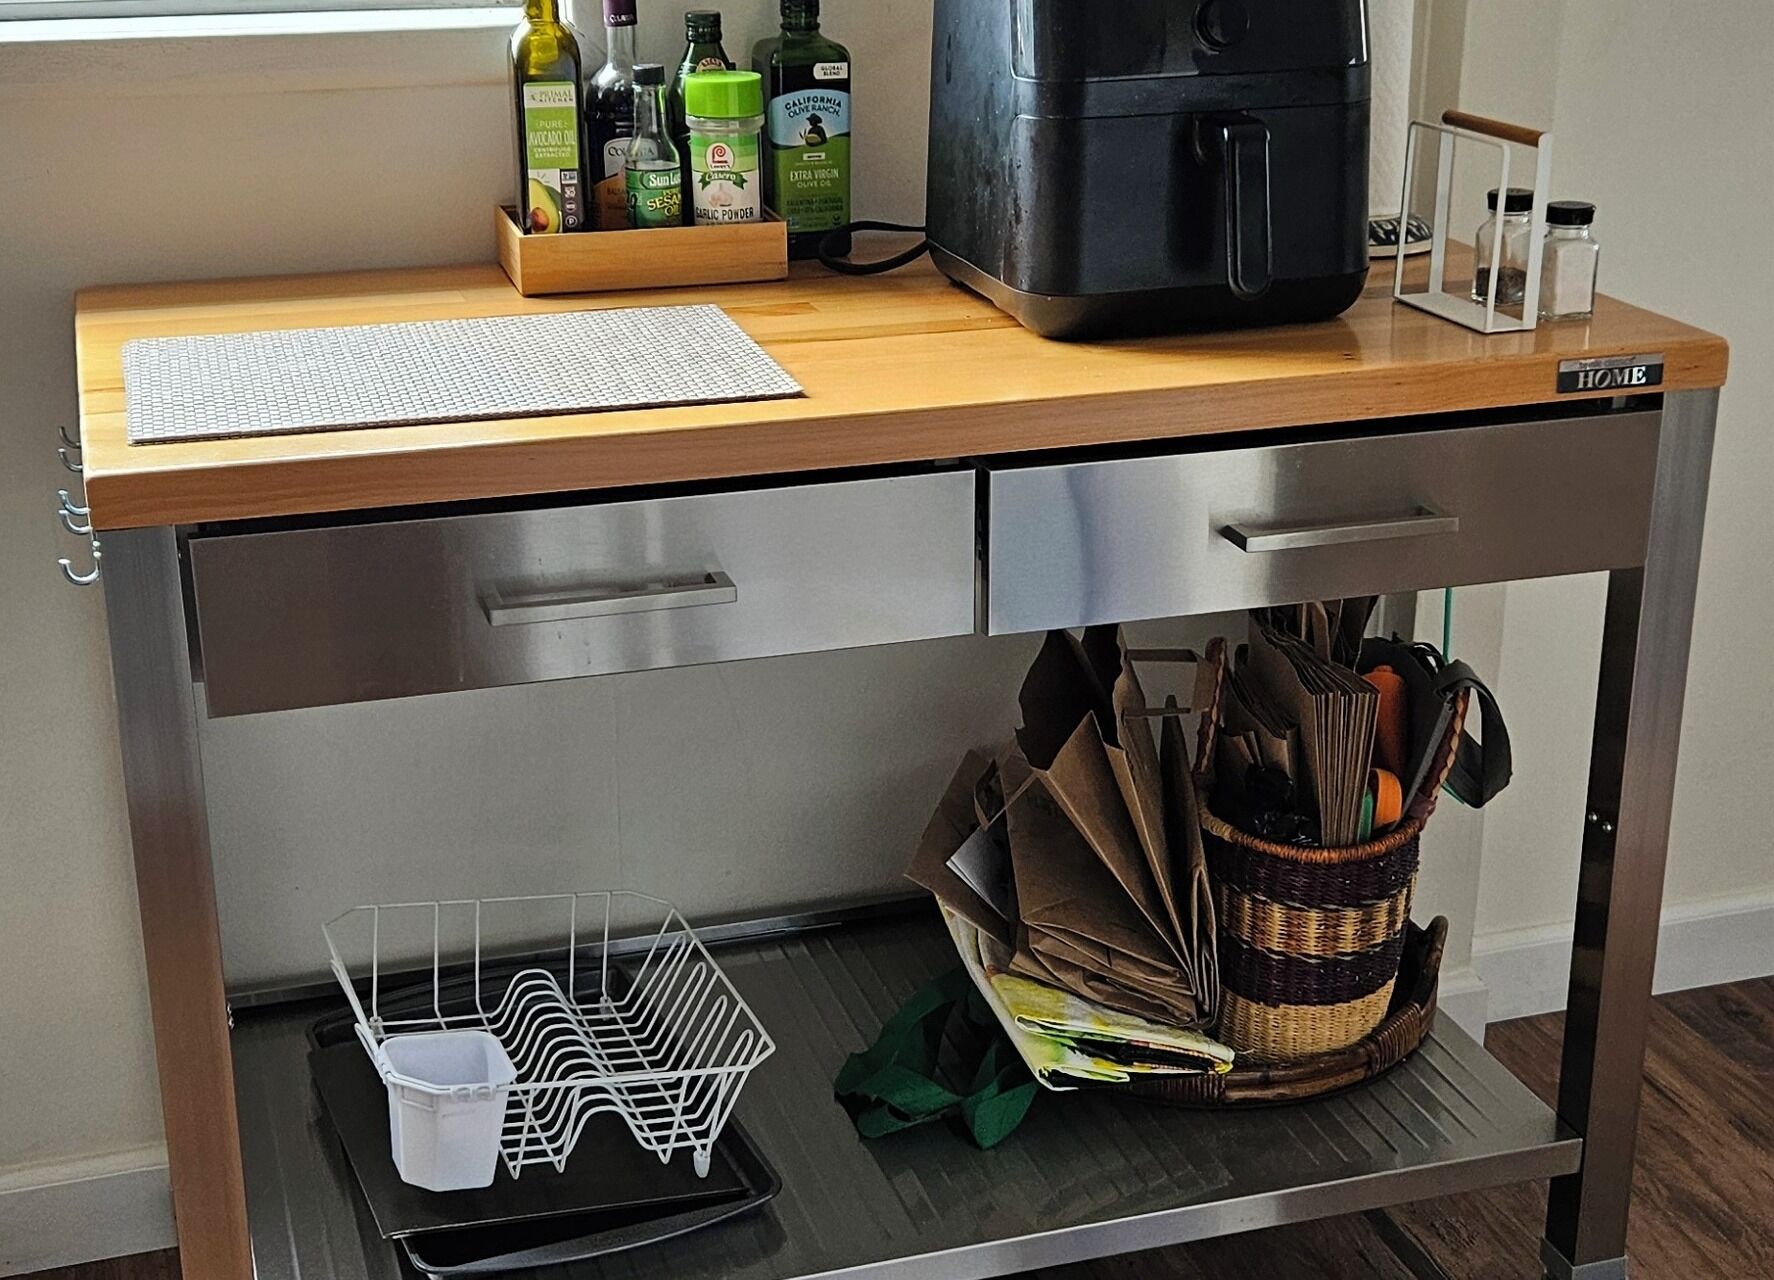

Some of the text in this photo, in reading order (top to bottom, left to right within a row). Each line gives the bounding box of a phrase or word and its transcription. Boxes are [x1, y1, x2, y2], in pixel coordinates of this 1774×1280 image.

[784, 95, 842, 111] CALIFORNIA
[788, 105, 811, 118] OLIVE
[529, 130, 576, 146] AVOCADO OIL
[649, 175, 670, 187] Sun
[705, 172, 736, 181] Casero
[790, 167, 839, 181] EXTRA VIRGIN
[797, 180, 818, 188] OLIVE
[696, 206, 754, 220] GARLIC POWDER
[1577, 366, 1647, 389] HOME
